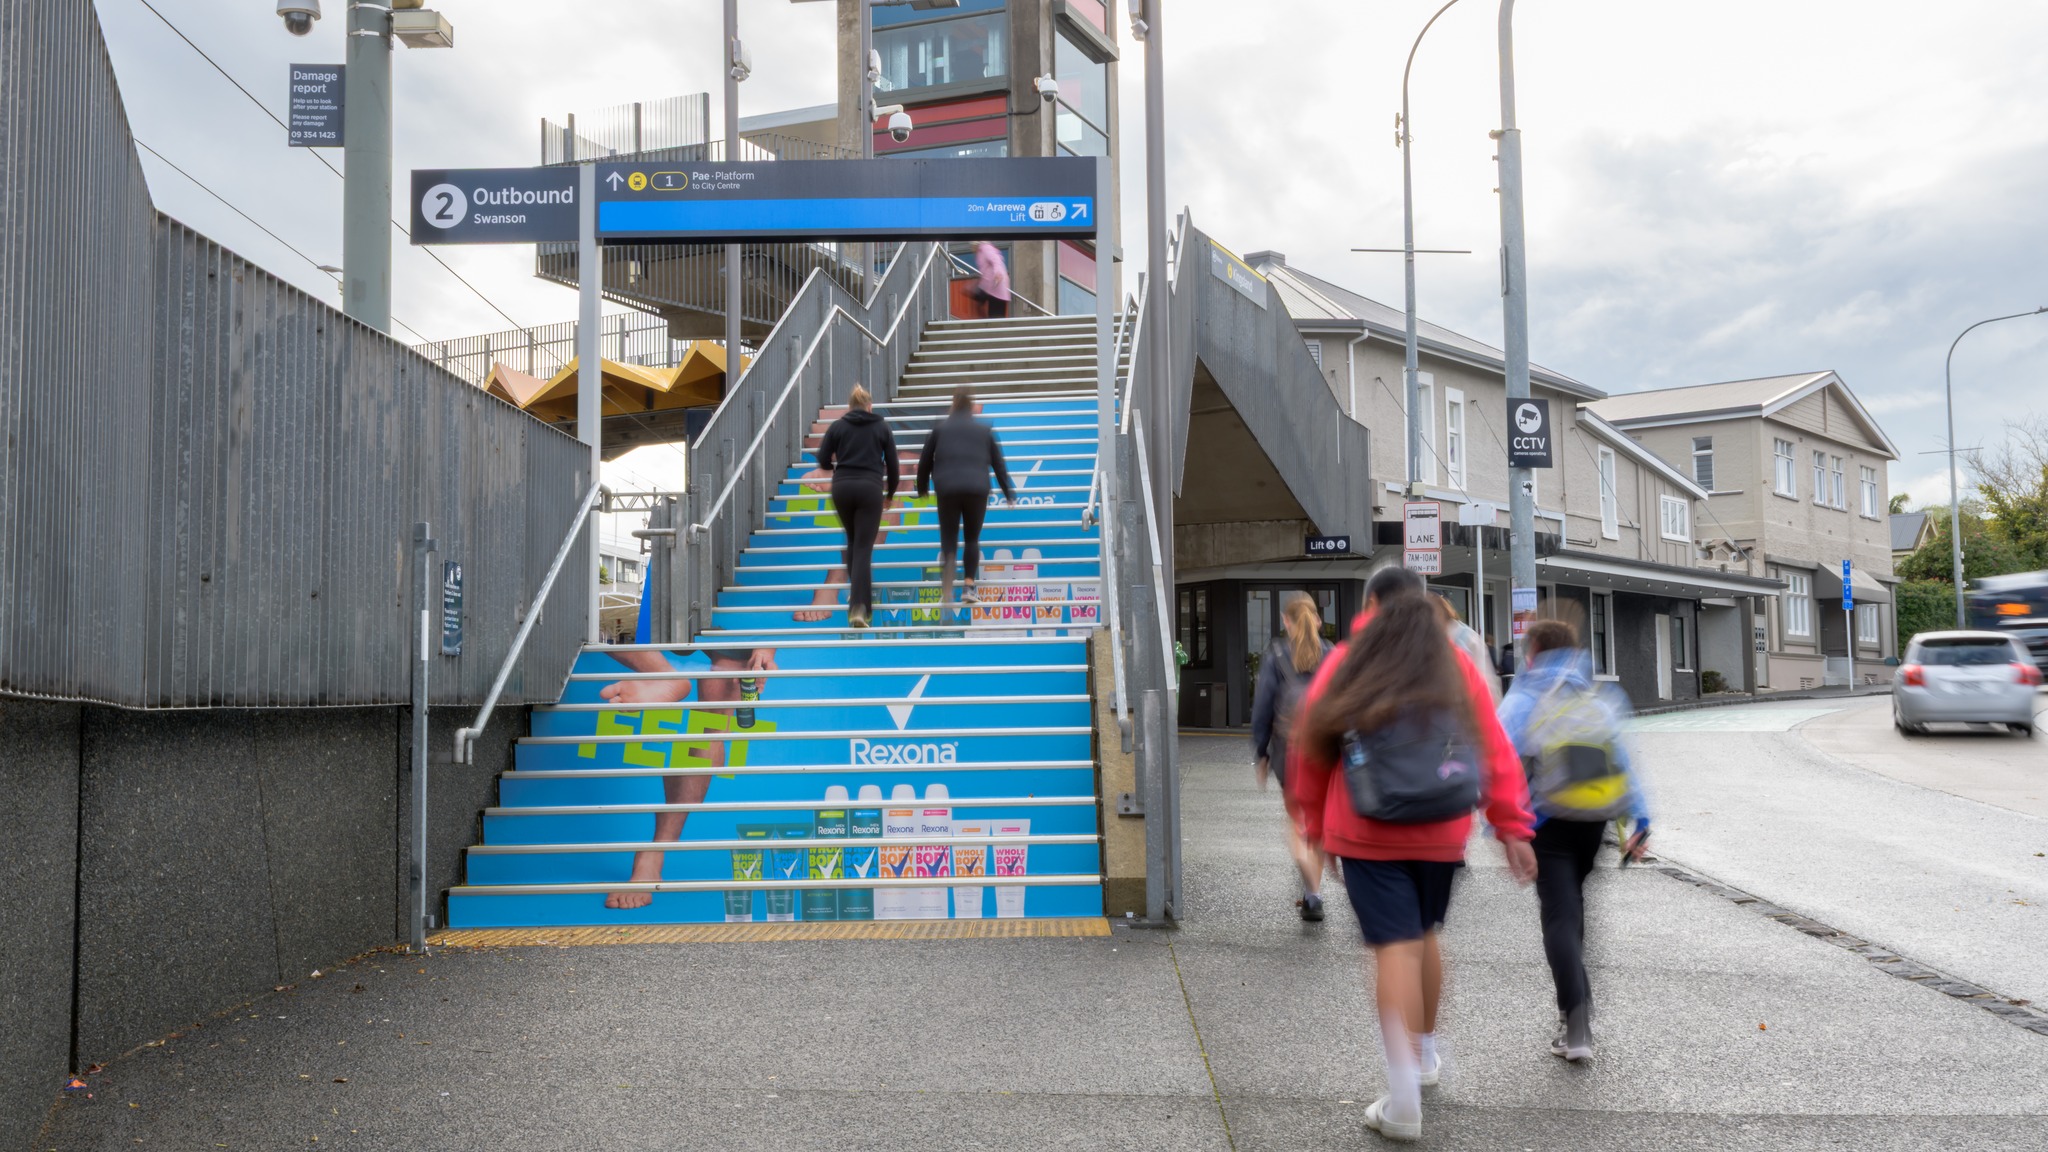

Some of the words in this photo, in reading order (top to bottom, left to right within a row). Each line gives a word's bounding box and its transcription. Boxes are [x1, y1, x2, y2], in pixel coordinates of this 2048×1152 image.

[294, 71, 338, 82] Damage
[294, 84, 326, 94] report
[692, 172, 710, 180] Pae
[715, 171, 754, 180] Platform
[666, 176, 673, 186] 1
[702, 182, 715, 191] City
[473, 186, 573, 205] Outbound
[435, 192, 454, 220] 2
[987, 203, 1025, 211] Ararewa
[474, 213, 526, 224] Swanson
[1010, 213, 1026, 222] Lift
[1514, 437, 1545, 450] CCTV
[1410, 535, 1435, 543] LANE
[1311, 541, 1324, 550] Lift
[1408, 554, 1438, 562] 7AM-10AM
[919, 588, 943, 596] WHO
[577, 709, 777, 780] FEET
[850, 738, 957, 764] Rexona
[818, 826, 845, 835] Rexona
[853, 825, 880, 834] Rexona
[887, 825, 914, 834] Rexona
[922, 824, 948, 833] Rexona
[809, 868, 843, 879] DO
[880, 867, 914, 877] DO
[916, 866, 950, 877] DO
